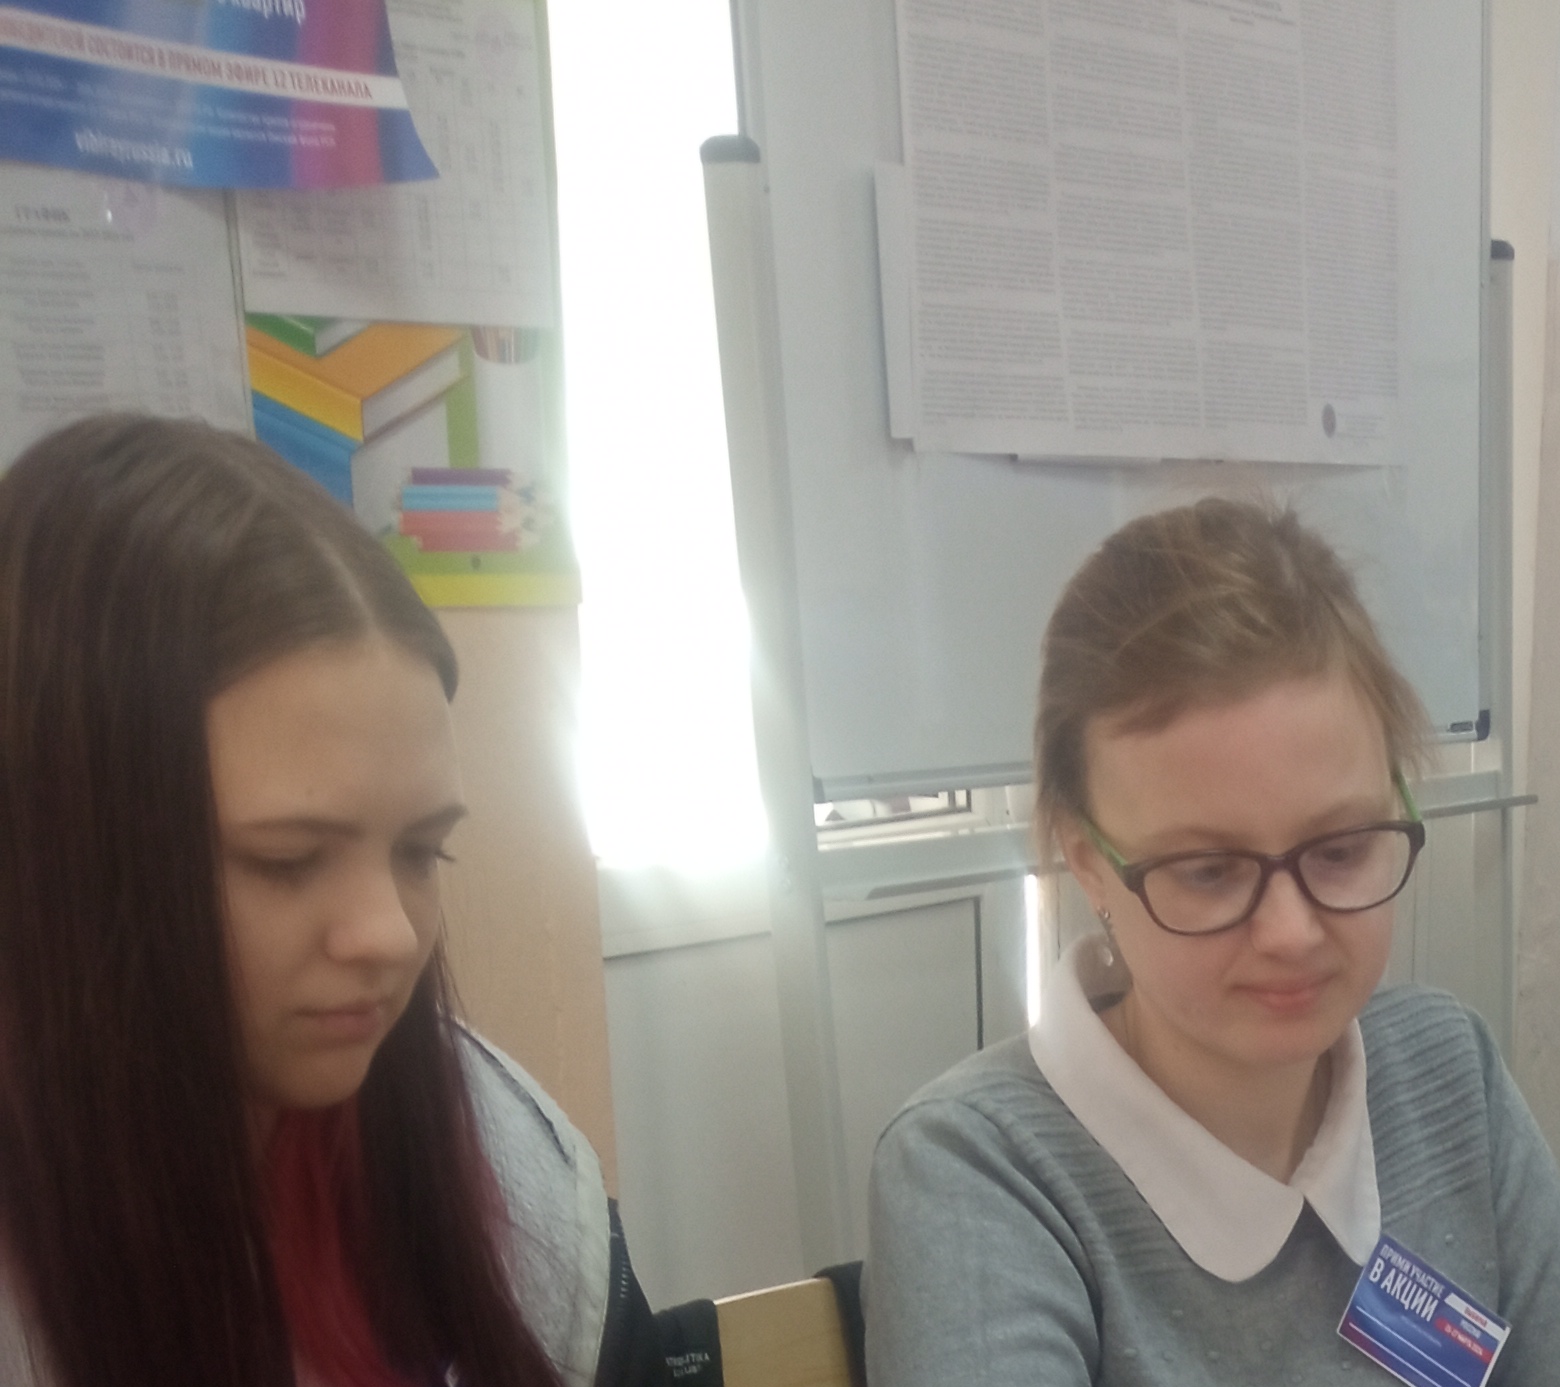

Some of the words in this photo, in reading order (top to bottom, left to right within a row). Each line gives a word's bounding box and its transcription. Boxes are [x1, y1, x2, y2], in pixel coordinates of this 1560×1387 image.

[291, 73, 373, 100] ТЕЛЕКАНАЛА
[1369, 1258, 1385, 1283] В
[1381, 1269, 1439, 1321] АКЦИИ
